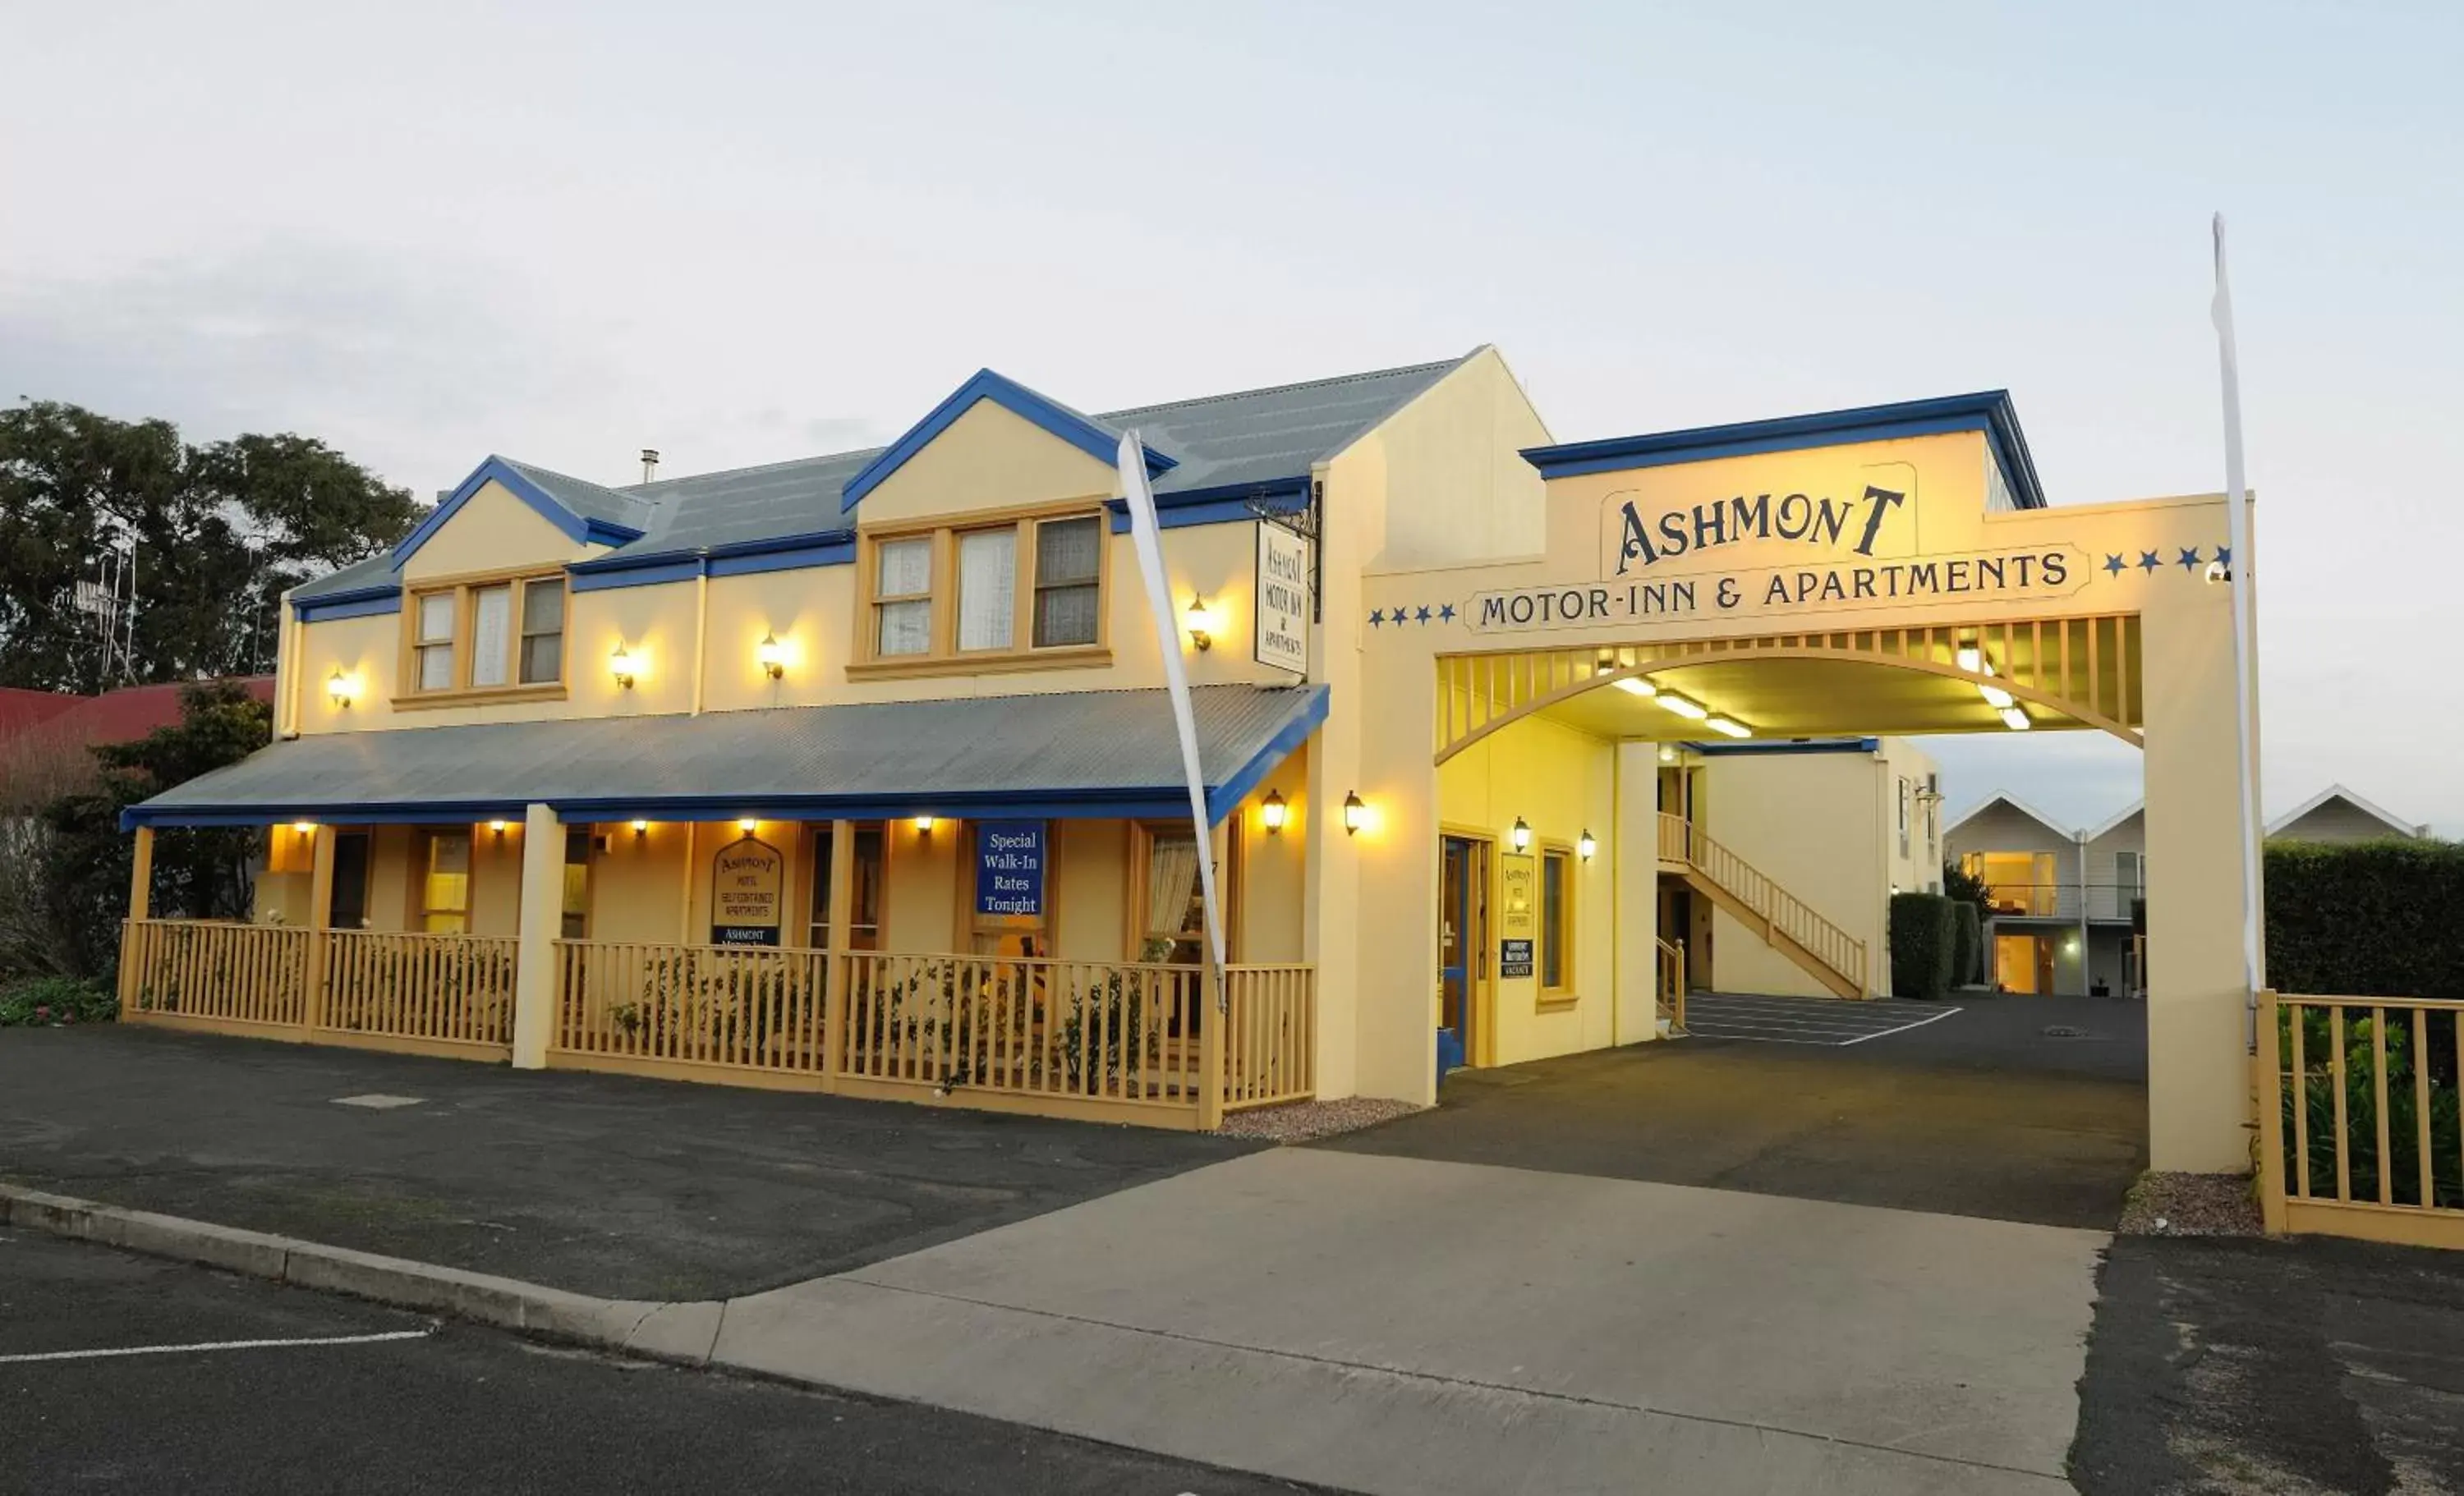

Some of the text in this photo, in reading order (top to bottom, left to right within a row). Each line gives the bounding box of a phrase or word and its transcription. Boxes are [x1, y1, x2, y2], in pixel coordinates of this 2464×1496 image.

[1616, 486, 1905, 576] ASHMONT
[1479, 553, 2068, 626] MOTOR-INN & APARTMENTS
[990, 833, 1037, 851] Special
[722, 857, 775, 874] ASHMONT
[985, 854, 1037, 870] Walk-In
[994, 876, 1030, 891] Rates
[985, 897, 1037, 915] Tonight
[725, 929, 765, 940] ASHMONT
